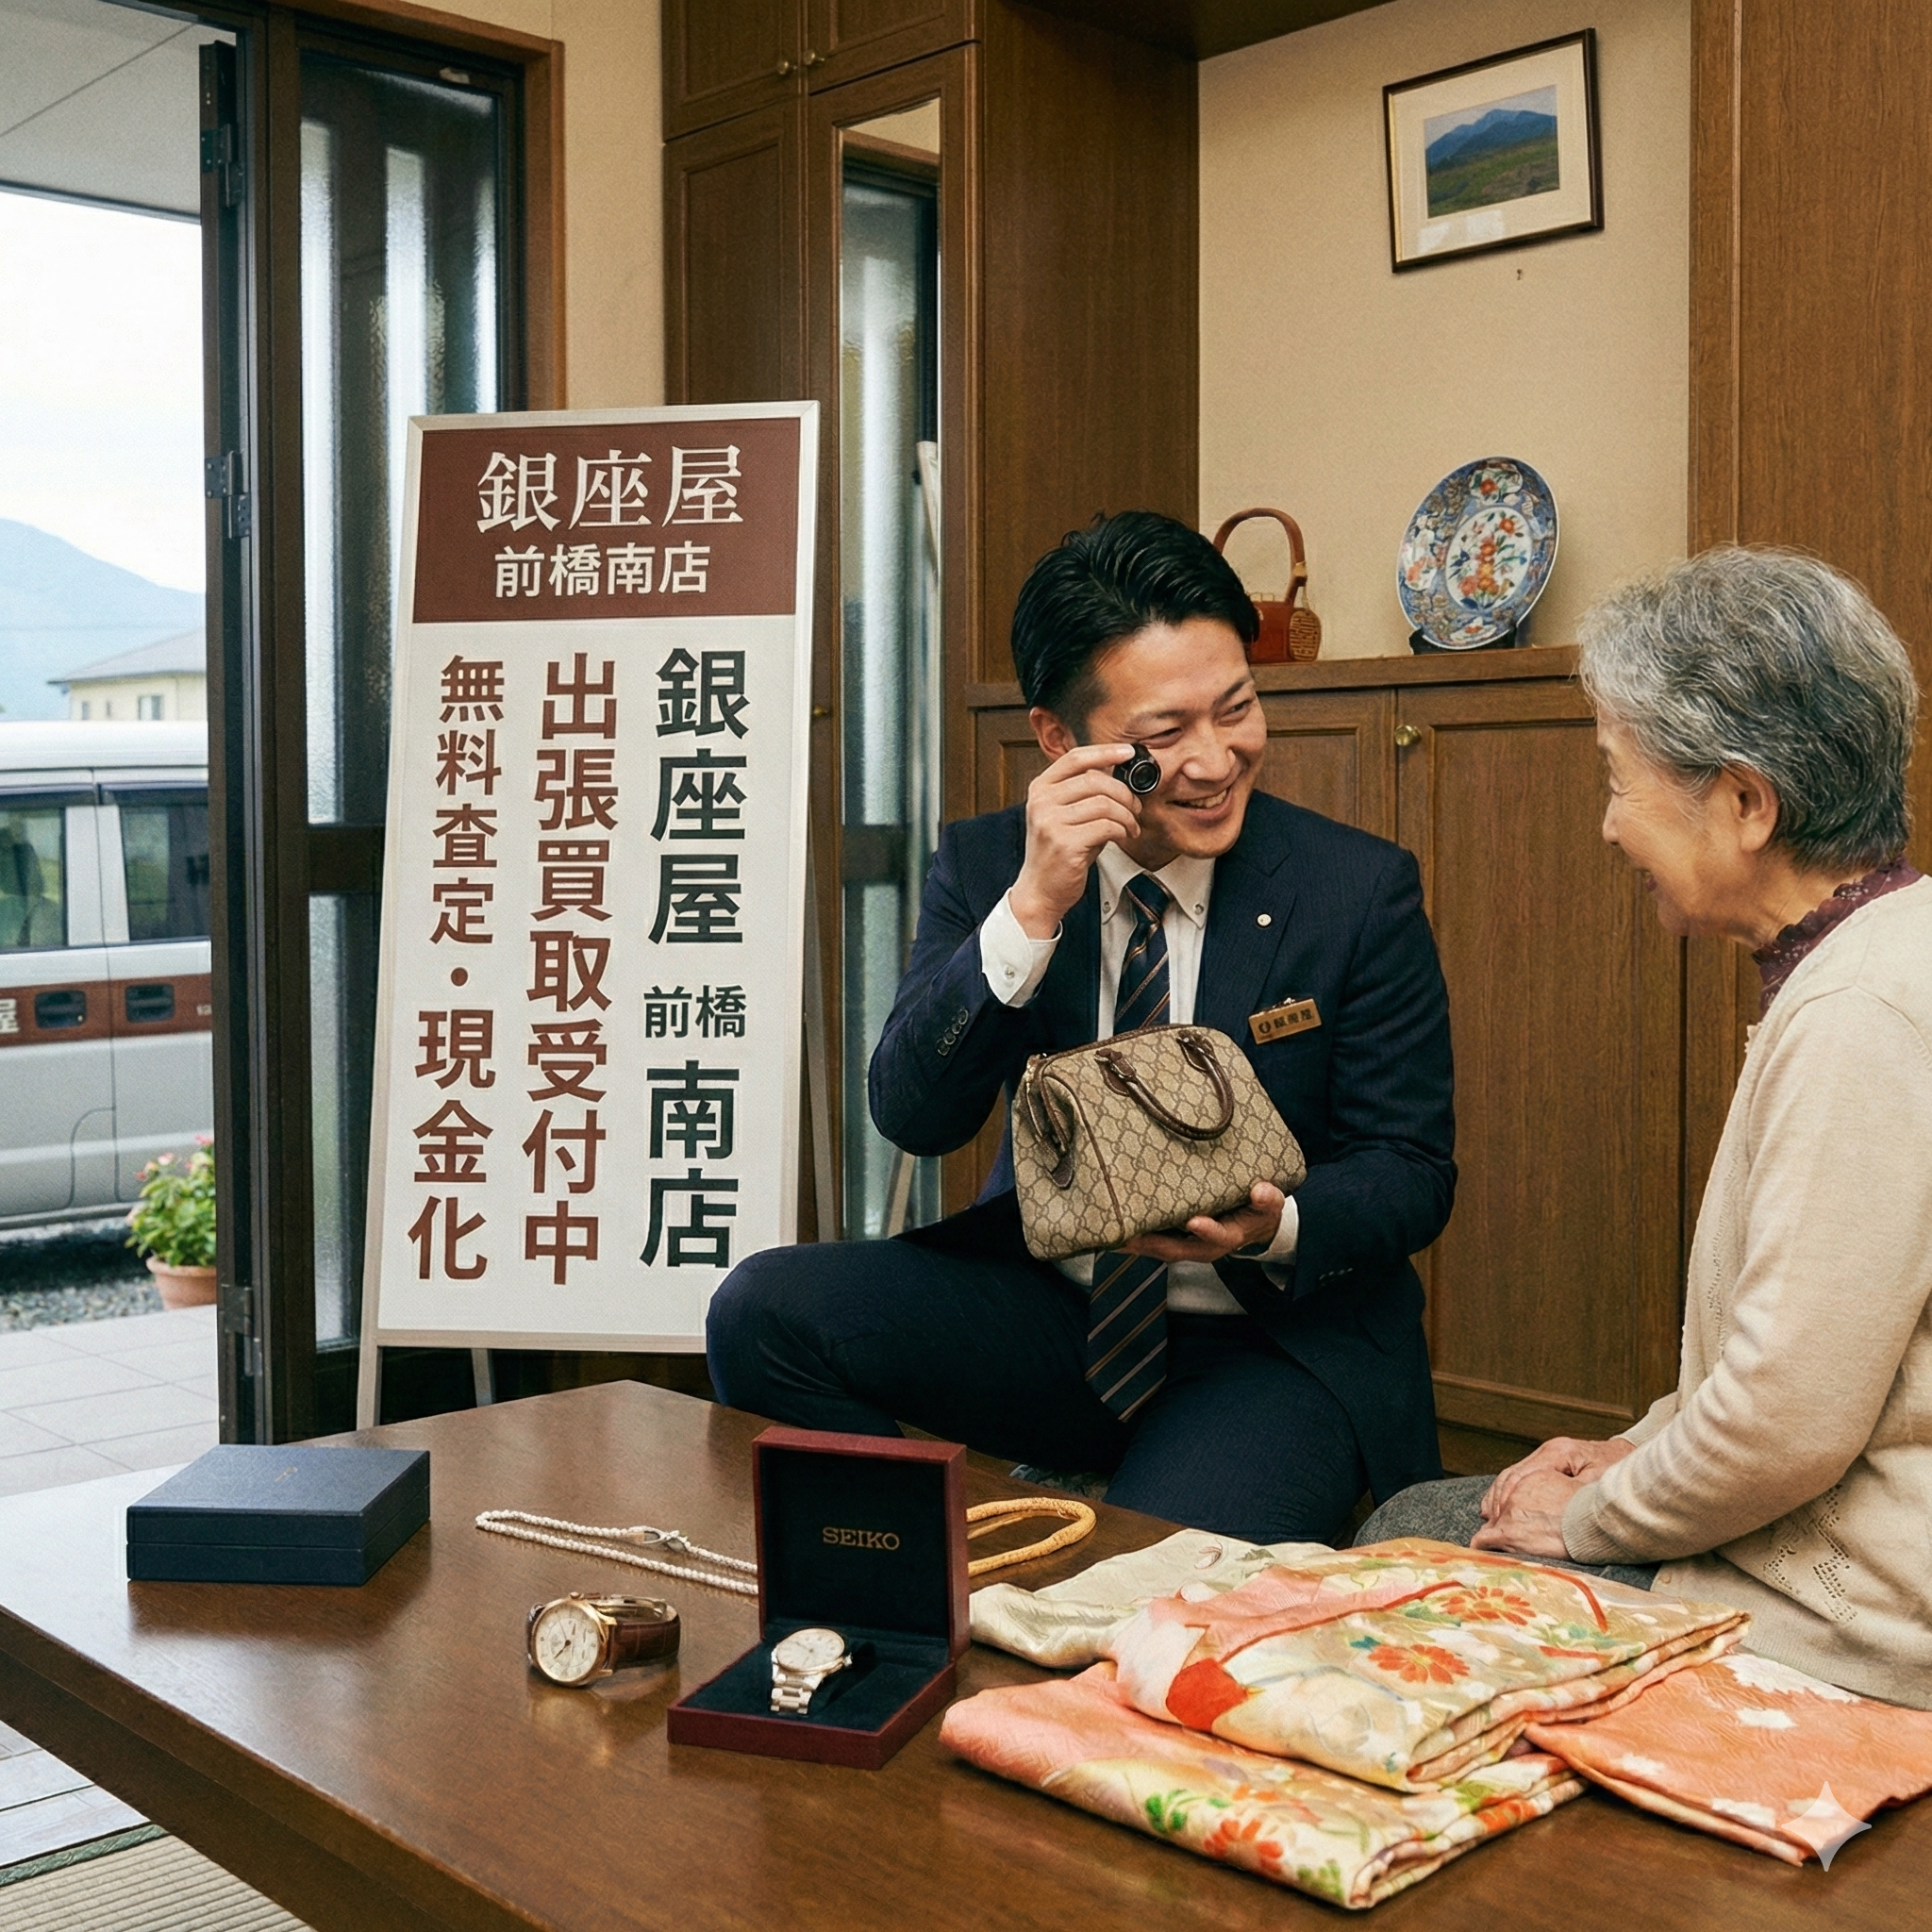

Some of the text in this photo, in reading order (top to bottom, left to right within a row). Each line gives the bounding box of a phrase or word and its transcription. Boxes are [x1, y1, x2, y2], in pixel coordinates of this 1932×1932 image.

[476, 444, 743, 533] 銀座屋
[494, 540, 711, 598] 前橋南店
[649, 647, 751, 944] 銀座屋
[408, 655, 505, 1280] 無料査定・現金化
[522, 652, 619, 1285] 出張買取受付中
[823, 1526, 900, 1550] SEIKO
